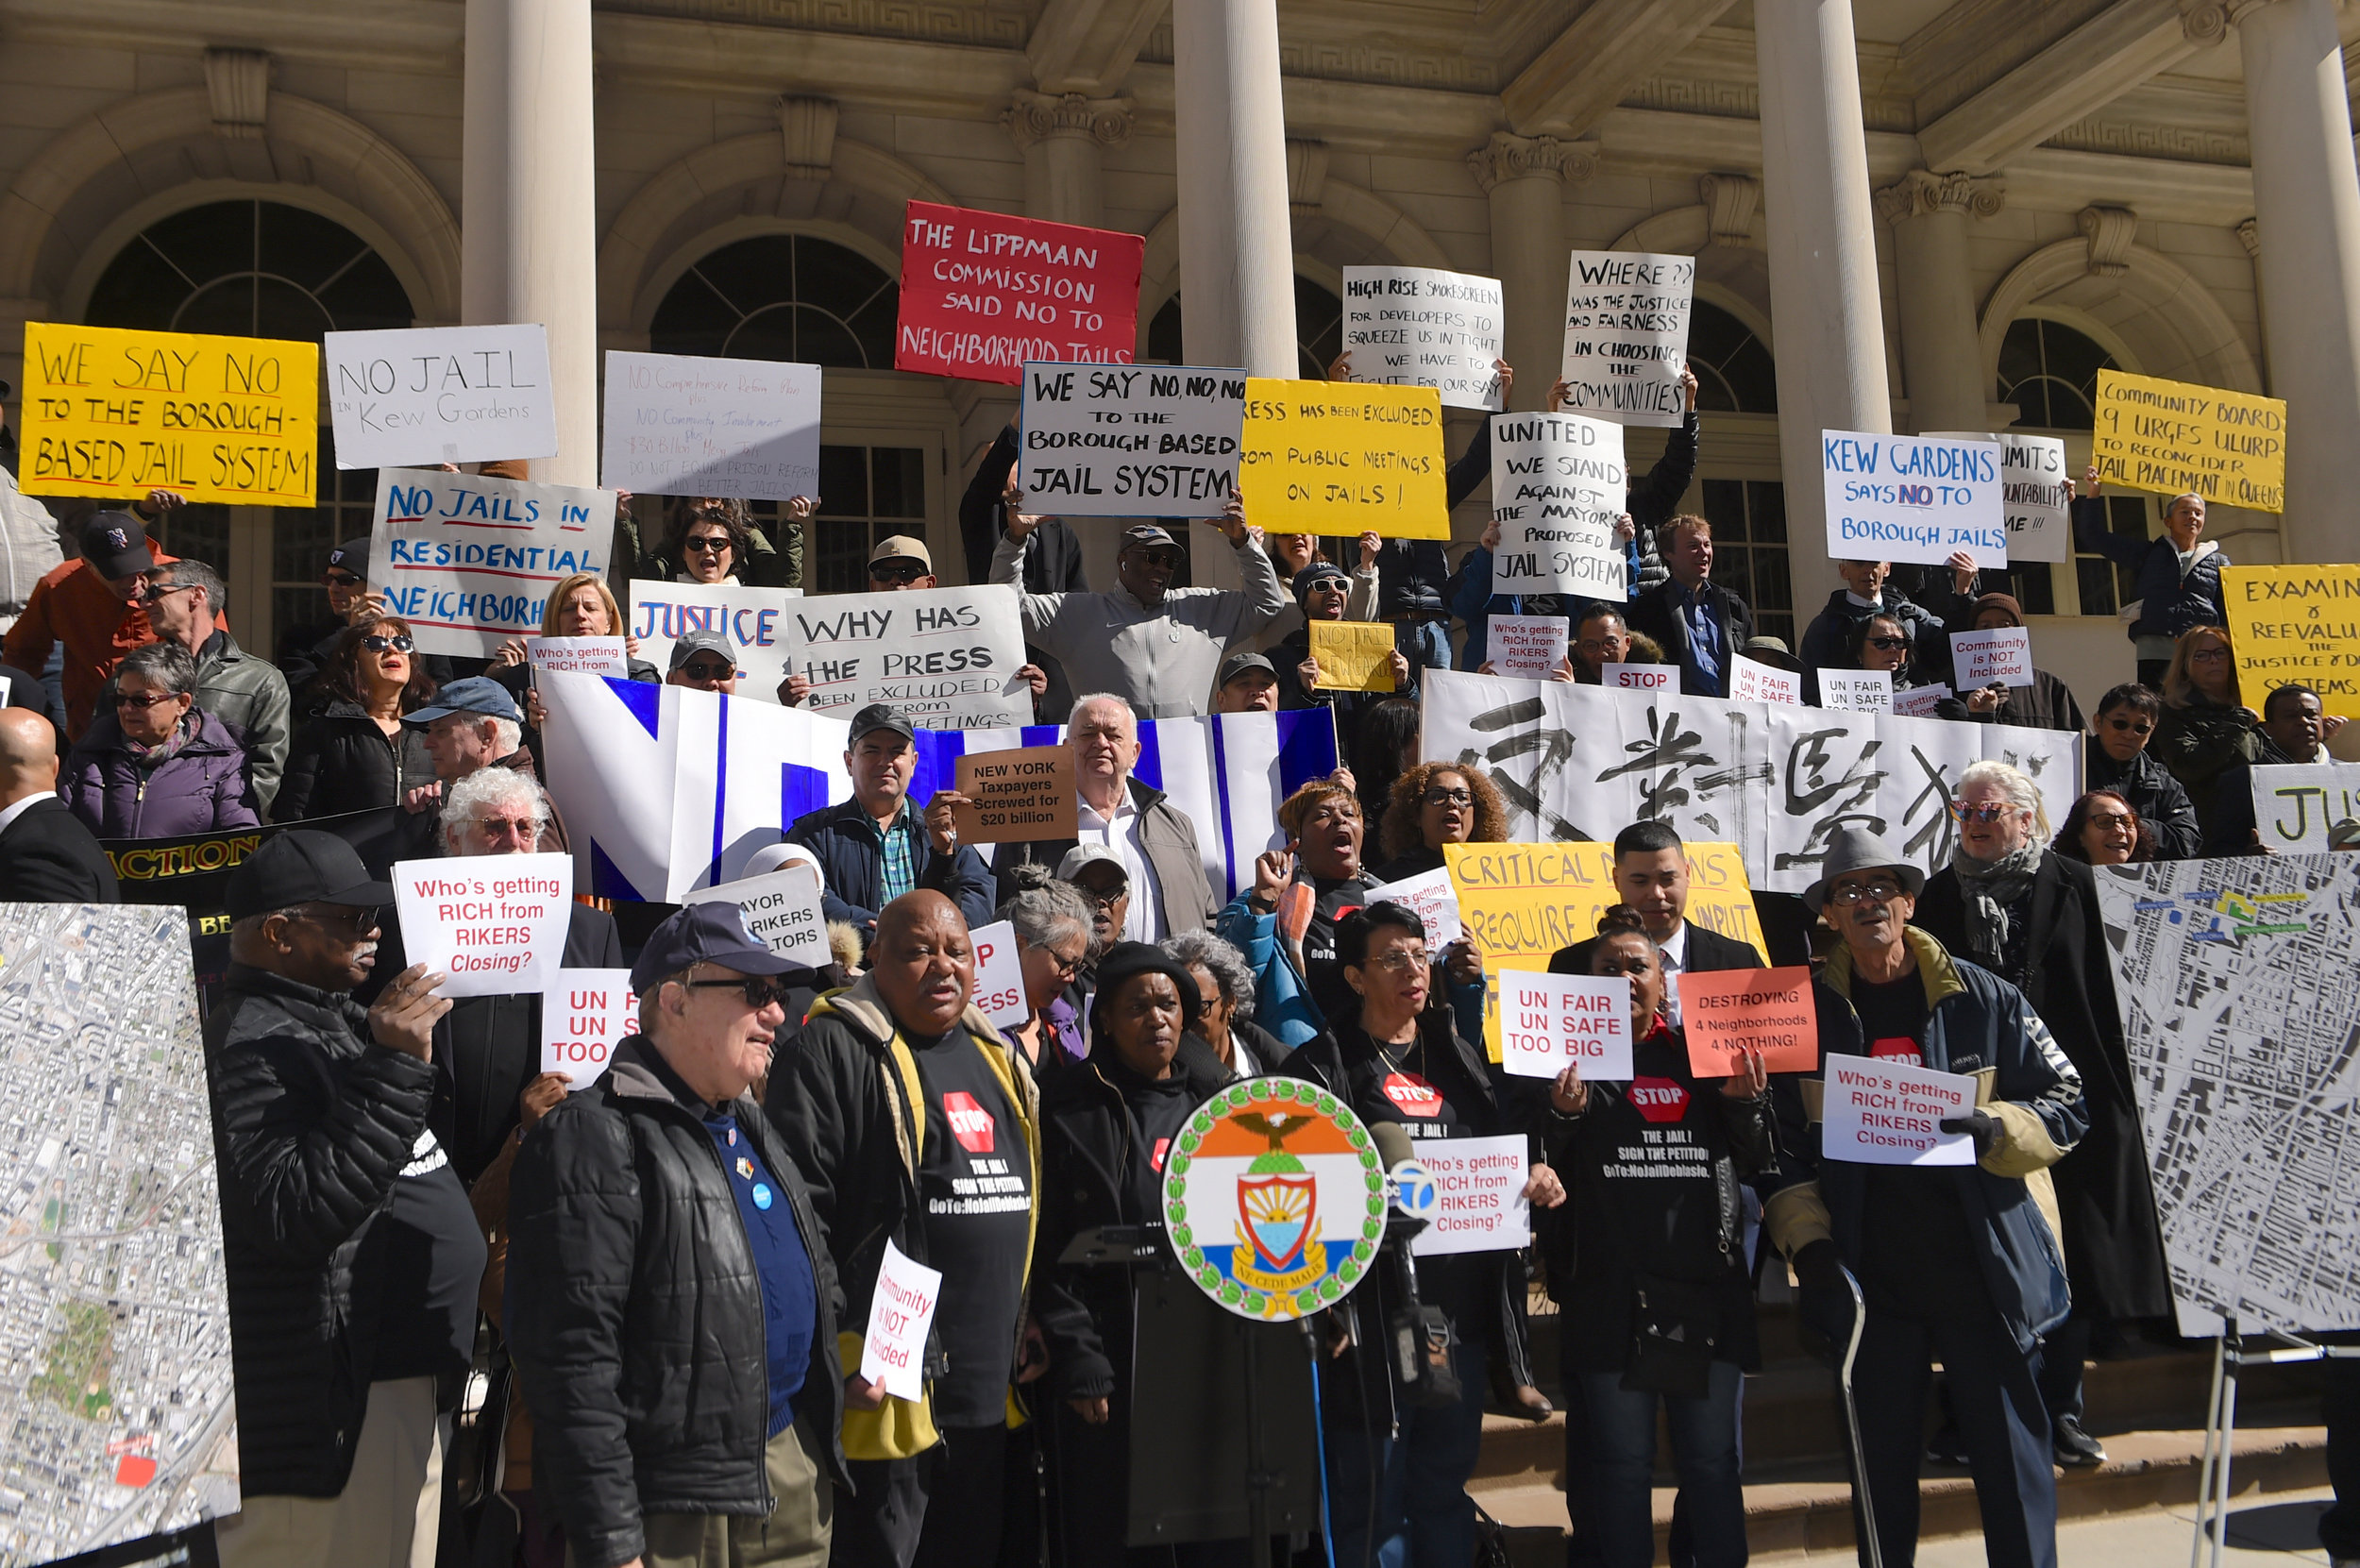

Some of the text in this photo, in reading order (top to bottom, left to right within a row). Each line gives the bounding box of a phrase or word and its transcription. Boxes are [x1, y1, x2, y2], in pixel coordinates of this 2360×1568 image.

[910, 219, 1097, 269] THE LIPPMAN
[933, 259, 1095, 304] COMMISSION
[1578, 259, 1665, 286] WHERE
[1348, 278, 1498, 305] HIGH RISE SMOKESCREEN
[1572, 295, 1690, 311] WAS THE JUSTICE
[941, 292, 1103, 331] SAID NO TO
[1351, 310, 1492, 331] FOR DEVELOPERS TO
[1568, 312, 1677, 332] AND FAIRNESS
[1348, 329, 1497, 351] SQUEEZE US IN TIGHT
[1385, 353, 1484, 369] WE HAVE TO
[1575, 337, 1678, 368] IN CHOOSING
[39, 341, 279, 394] WE SAY NO
[339, 350, 535, 396] NO JAIL
[1606, 363, 1644, 375] THE
[1034, 371, 1245, 403] WE SAY NO, NO, NO
[1444, 379, 1501, 396] OUR SAY
[1562, 379, 1683, 413] COMMUNITIES
[38, 398, 298, 435] TO THE BOROUGH-
[337, 393, 530, 433] IN Kew Gardens
[1087, 412, 1176, 424] TO THE
[1300, 404, 1433, 426] HAS BEEN EXCLUDED
[2104, 382, 2281, 431] COMMUNITY BOARD
[1499, 419, 1595, 446] UNITED
[2103, 407, 2279, 458] 9 URGES ULURP
[35, 437, 309, 496] BASED JAIL SYSTEM
[1289, 447, 1430, 475] PUBLIC MEETINGS
[1826, 438, 1995, 482] KEW GARDENS
[2100, 437, 2248, 476] TO RECONCIDER
[1029, 464, 1234, 500] JAIL SYSTEM
[1507, 457, 1622, 484] WE STAND
[2096, 454, 2130, 481] JAIL
[2137, 461, 2220, 497] PLACEMENT
[2238, 478, 2283, 510] QUEENS
[387, 485, 590, 523] NO JAILS IN
[1288, 483, 1310, 501] ON
[1515, 484, 1604, 504] AGAINST
[1846, 481, 1972, 506] SAYS NO TO
[1494, 505, 1622, 529] THE MAYOR'S
[1525, 528, 1604, 548] PROPOSED
[1842, 517, 2006, 548] BOROUGH JAILS
[391, 539, 601, 573] RESIDENTIAL
[1496, 551, 1624, 590] JAIL SYSTEM
[797, 605, 980, 642] WHY HAS
[1494, 624, 1563, 636] Who's getting
[1503, 636, 1555, 646] RICH from
[1509, 648, 1549, 657] RIKERS
[1957, 638, 2026, 652] Community
[801, 647, 993, 684] THE PRESS
[1506, 659, 1551, 671] Closing?
[1974, 651, 2015, 664] is NOT
[1619, 672, 1667, 687] STOP
[1970, 665, 2021, 678] Included
[809, 678, 1000, 707] BEEN EXCLUDED
[974, 762, 1055, 778] NEW YORK
[979, 781, 1052, 795] Taxpayers
[974, 795, 1059, 809] Screwed for
[981, 812, 1054, 826] $20 billion
[1458, 851, 1595, 886] CRITICAL
[414, 876, 560, 898] Who's getting
[439, 902, 543, 921] RICH from
[456, 926, 531, 946] RIKERS
[450, 952, 532, 973] Closing?
[1519, 990, 1611, 1012] UN FAIR
[1699, 991, 1799, 1009] DESTROYING
[1520, 1012, 1621, 1035] UN SAFE
[1695, 1015, 1808, 1032] 4 Neighborhoods
[1509, 1033, 1604, 1056] TOO BIG
[1711, 1035, 1798, 1050] 4 NOTHING!
[1633, 1087, 1683, 1105] STOP
[1838, 1071, 1962, 1104] Who's getting
[1852, 1091, 1945, 1116] RICH from
[949, 1109, 986, 1133] STOP
[1862, 1112, 1932, 1133] RIKERS
[1857, 1131, 1937, 1151] Closing?
[880, 1266, 932, 1318] Community
[878, 1301, 909, 1335] is NOT
[870, 1329, 909, 1368] Included
